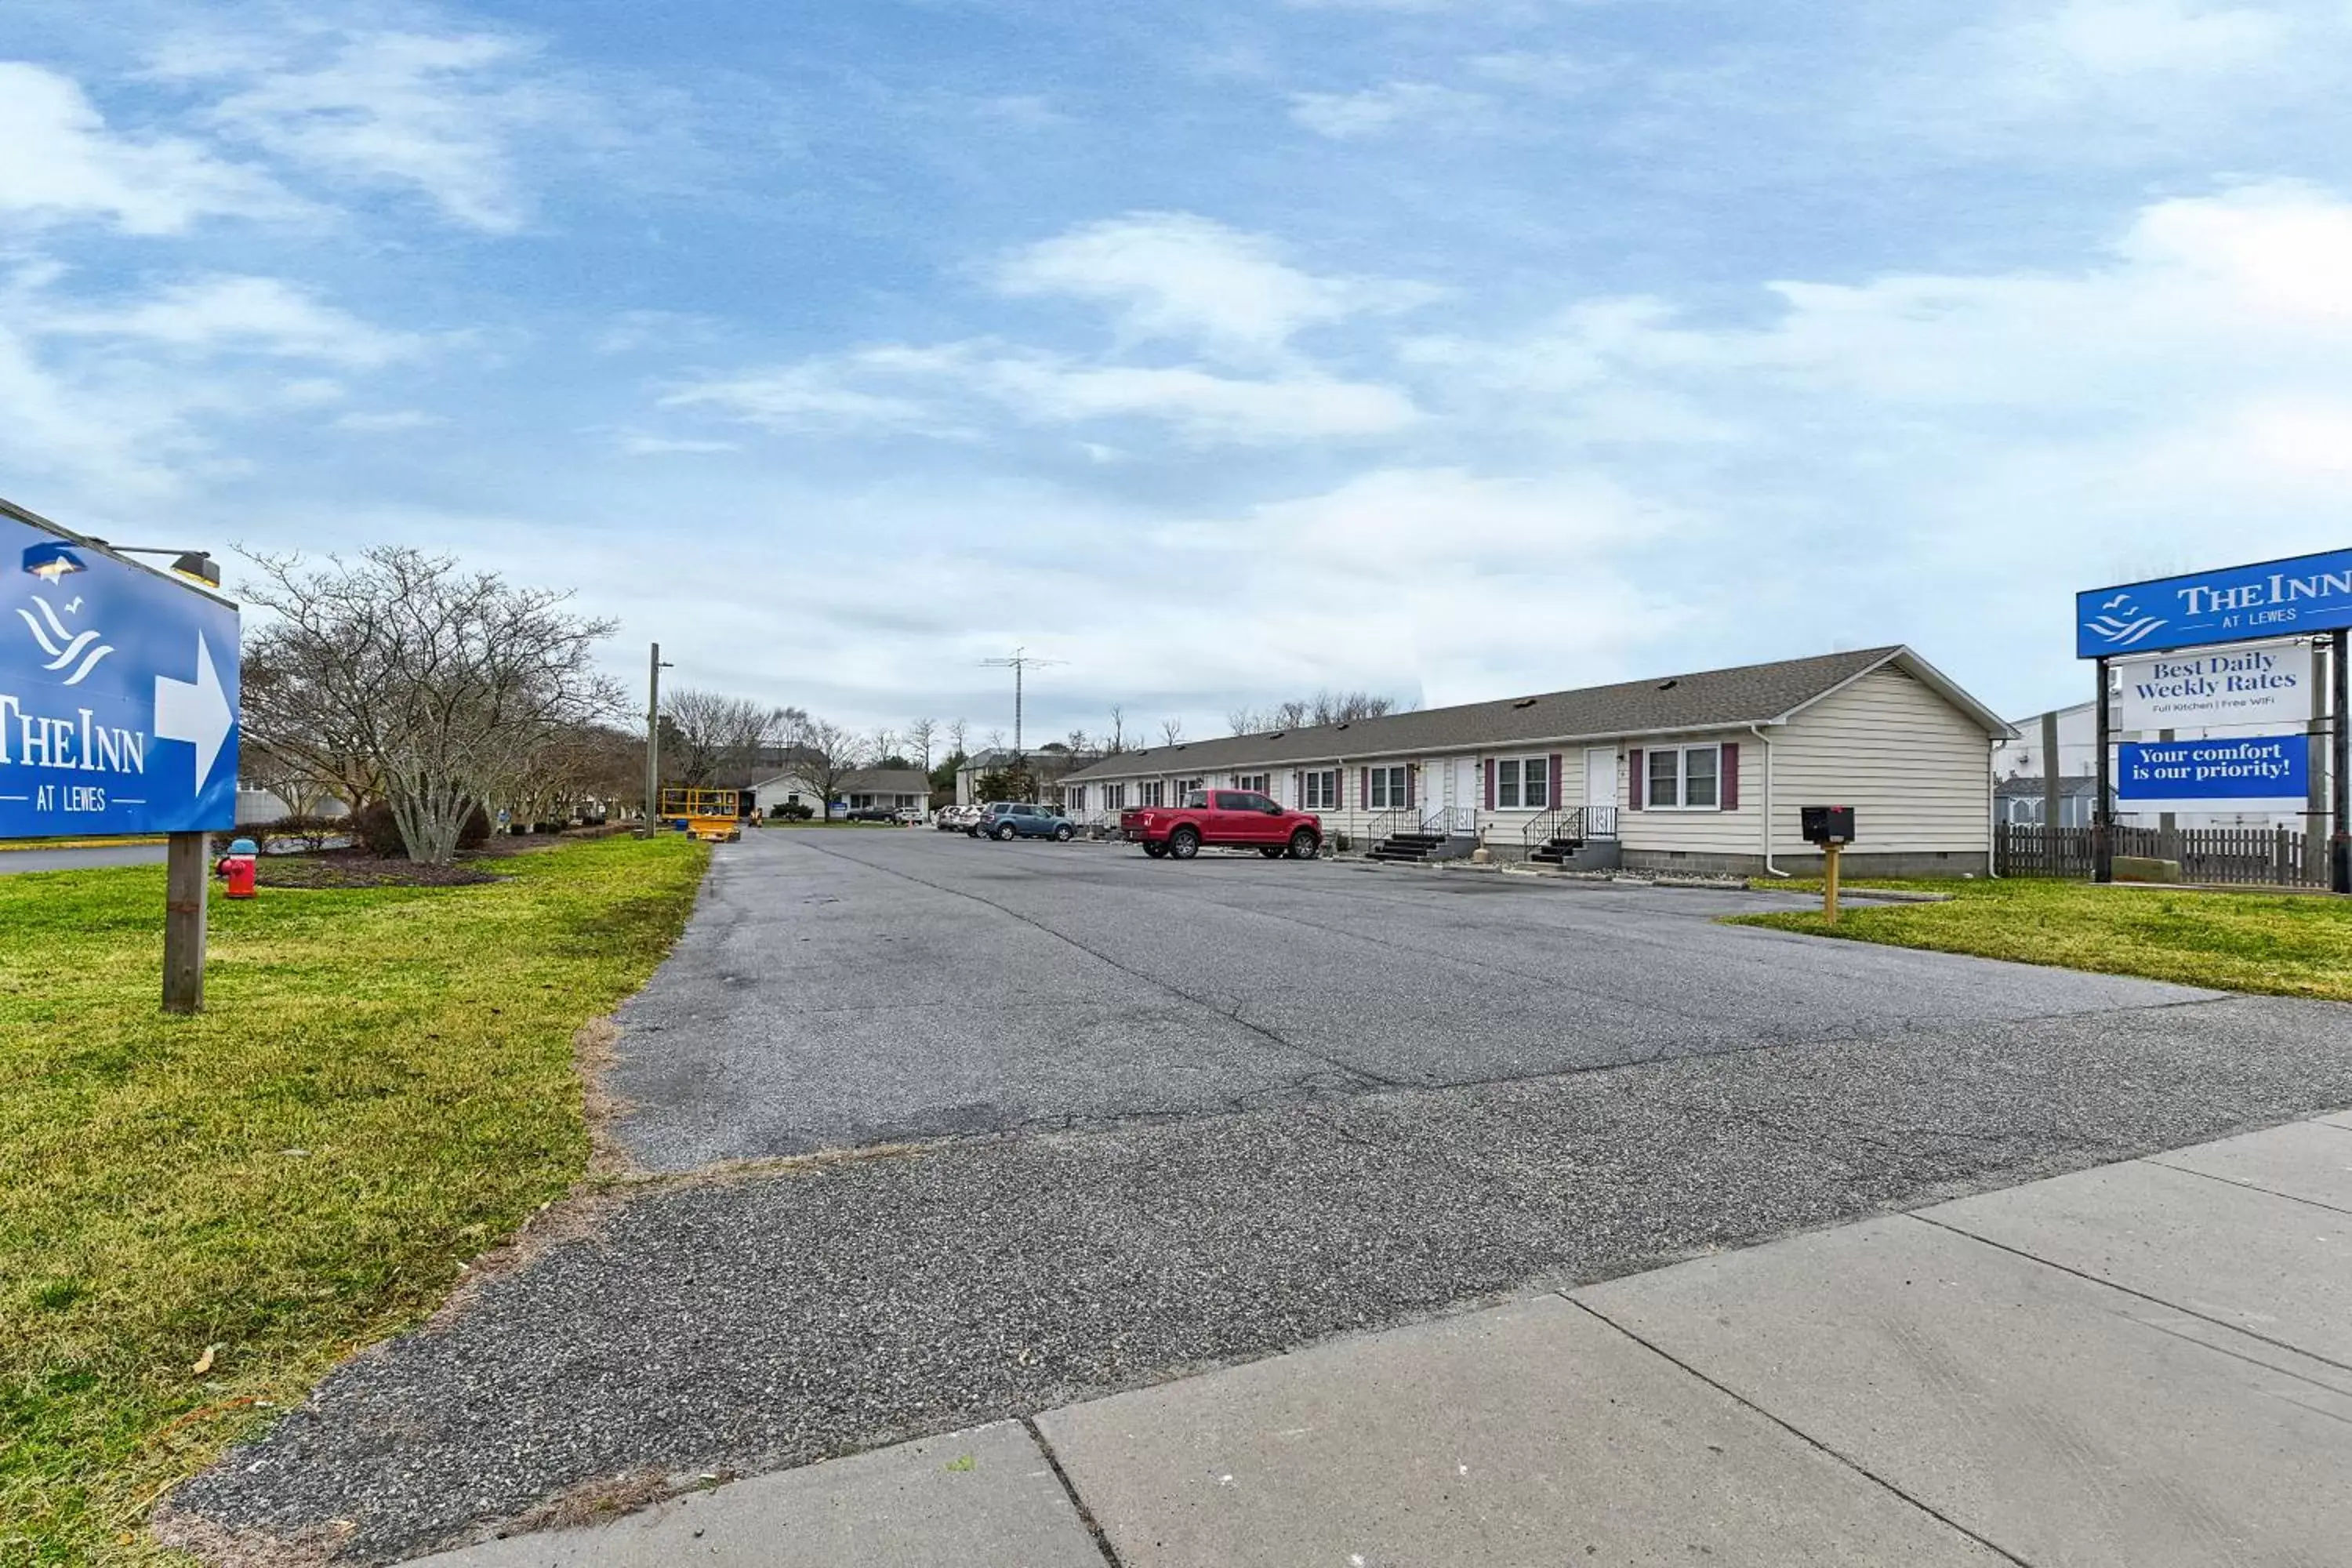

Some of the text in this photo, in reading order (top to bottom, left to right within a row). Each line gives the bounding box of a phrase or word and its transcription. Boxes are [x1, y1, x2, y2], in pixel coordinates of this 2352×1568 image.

[2223, 608, 2296, 629] AT LEWES
[2154, 652, 2276, 679] Best Daily
[2136, 673, 2296, 700] Weekly Rates
[2153, 704, 2171, 713] Full
[2173, 701, 2213, 711] Kitchen
[2140, 743, 2281, 763] Your comfort
[2132, 759, 2290, 781] is our priority!
[37, 785, 106, 811] AT LEWES
